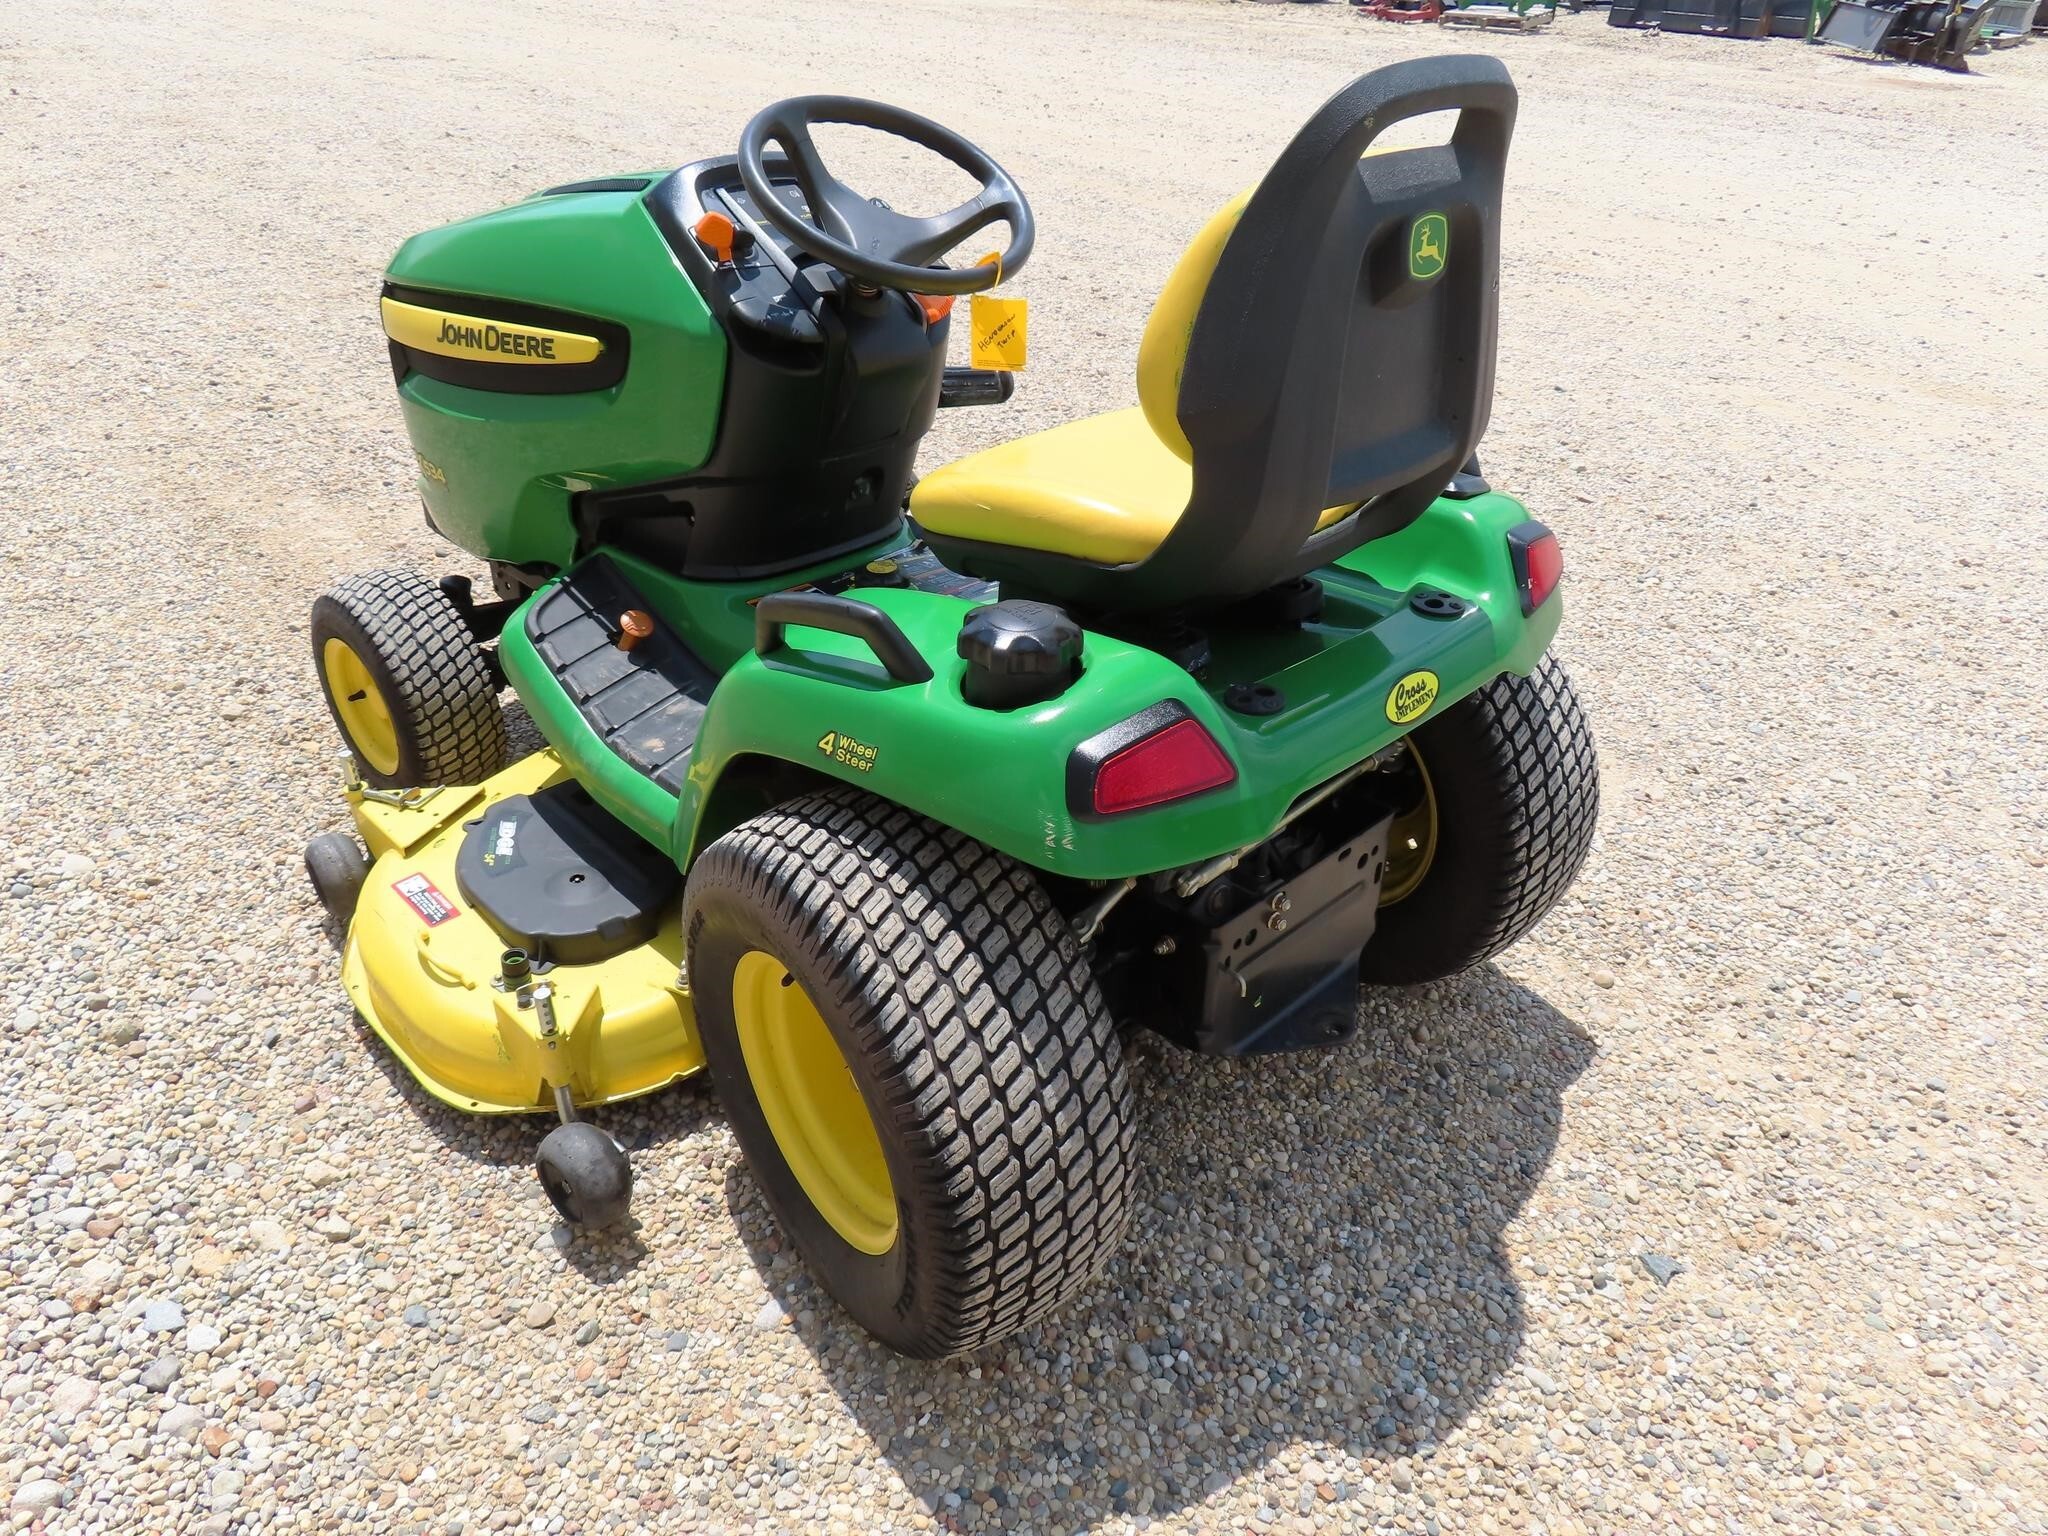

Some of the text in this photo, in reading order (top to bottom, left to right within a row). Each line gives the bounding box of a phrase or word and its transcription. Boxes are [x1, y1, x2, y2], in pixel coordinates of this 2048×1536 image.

[437, 318, 556, 360] JOHN DEERE
[1395, 678, 1428, 711] Cross
[1395, 687, 1435, 721] IMPLEMENT
[817, 731, 879, 761] 4 Wheel
[835, 748, 874, 773] Steer
